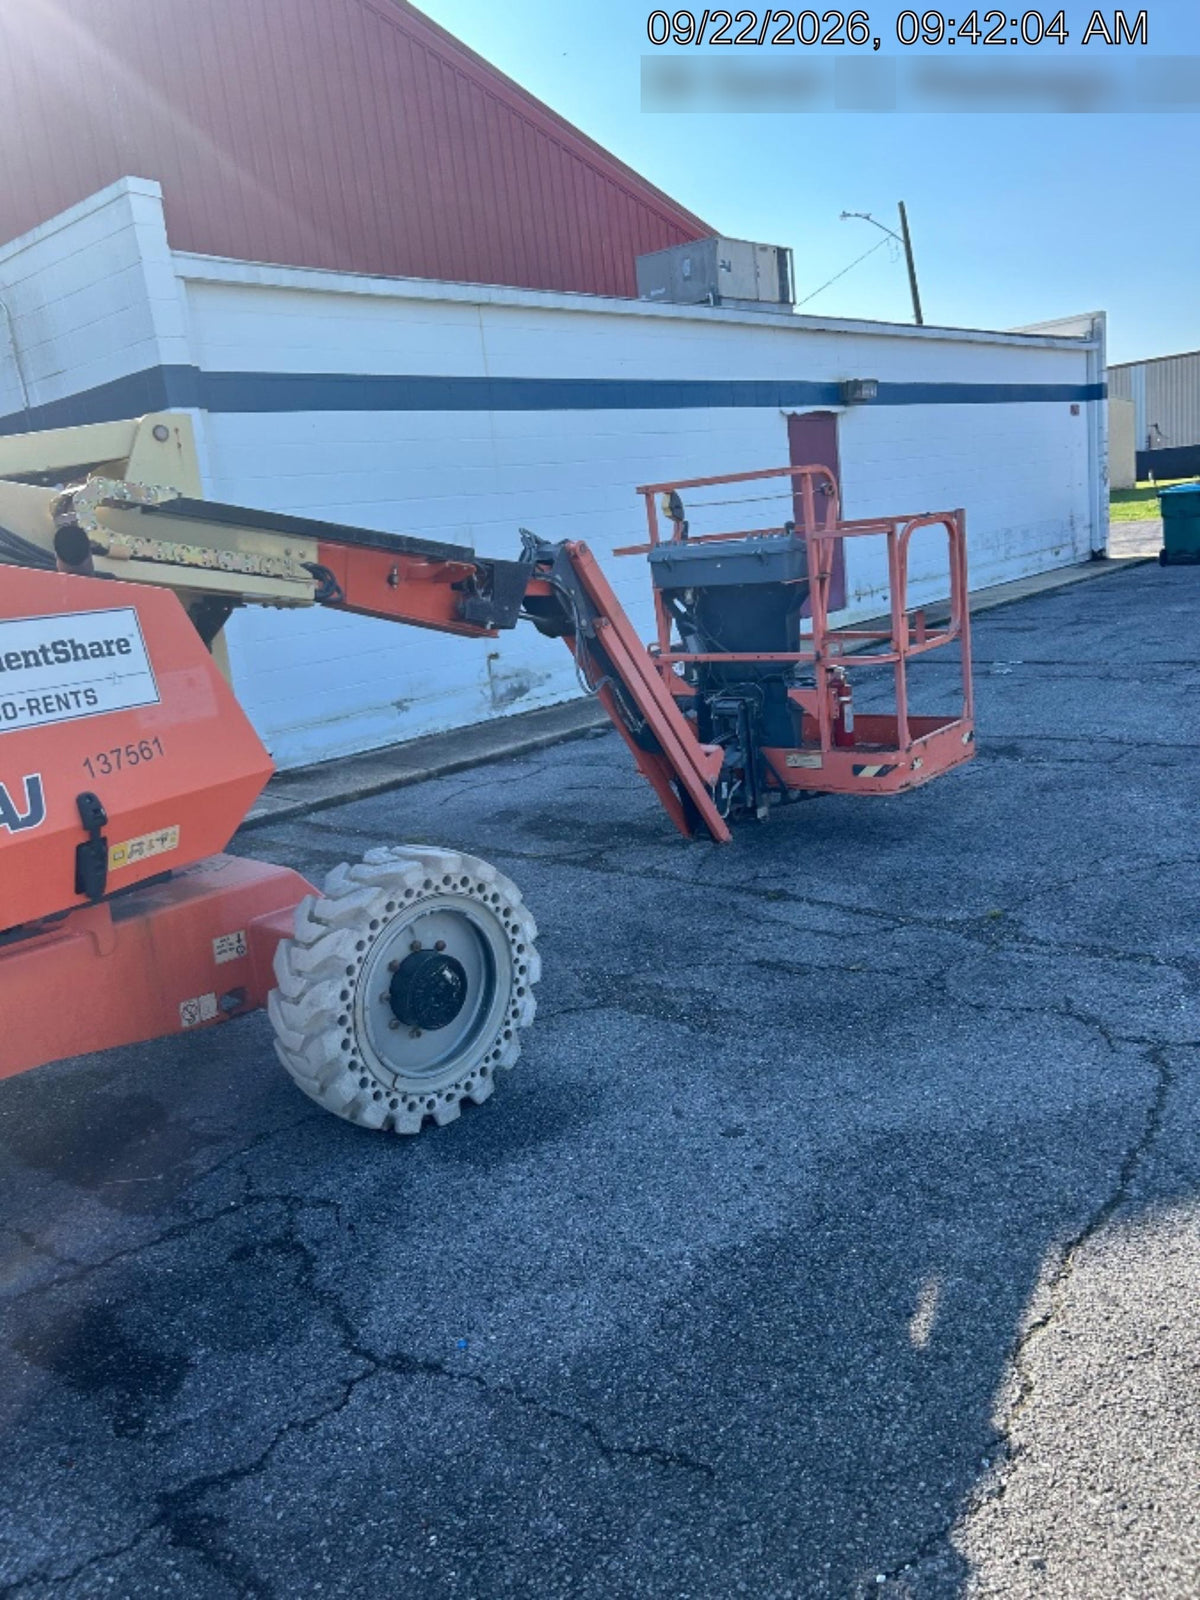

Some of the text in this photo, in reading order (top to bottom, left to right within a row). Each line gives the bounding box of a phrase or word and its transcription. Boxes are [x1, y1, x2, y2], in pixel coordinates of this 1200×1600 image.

[0, 637, 132, 673] entShare
[0, 687, 98, 721] 0-RENTS
[83, 736, 164, 778] 137561
